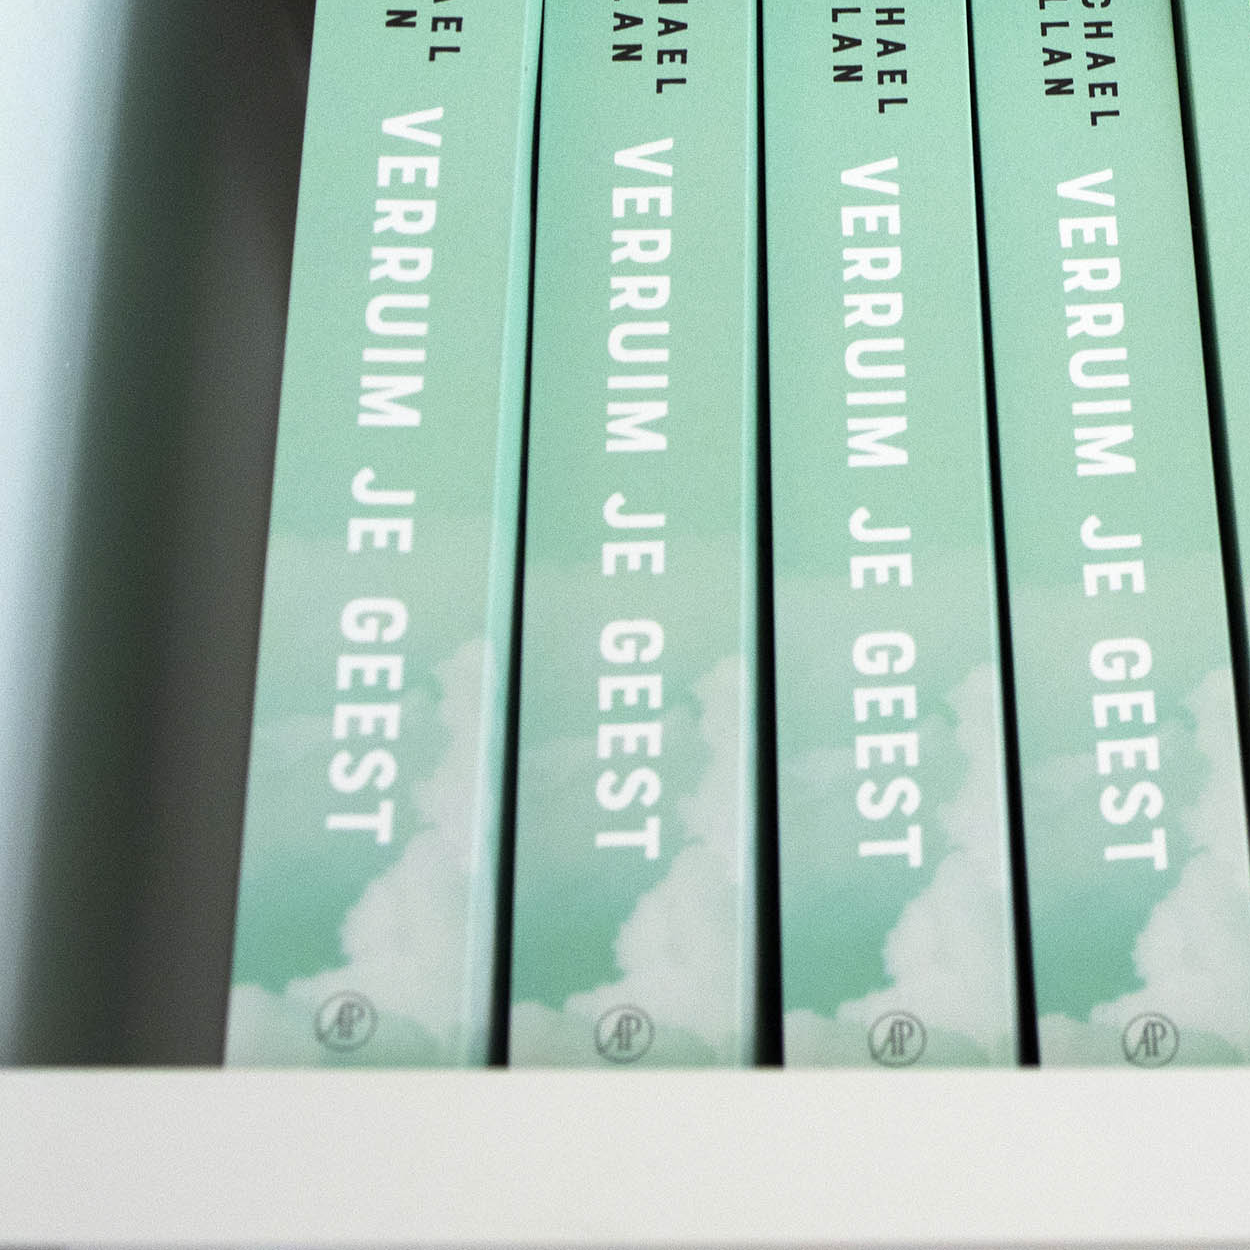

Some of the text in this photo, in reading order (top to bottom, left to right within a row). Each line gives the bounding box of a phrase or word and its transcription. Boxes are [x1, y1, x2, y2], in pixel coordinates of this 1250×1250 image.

[325, 106, 444, 846] VERRUIM JE GEEST
[595, 136, 674, 860] VERRUIM JE GEEST
[840, 156, 923, 870] VERRUIM JE GEEST
[1056, 168, 1168, 871] VERRUIM JE GEEST
